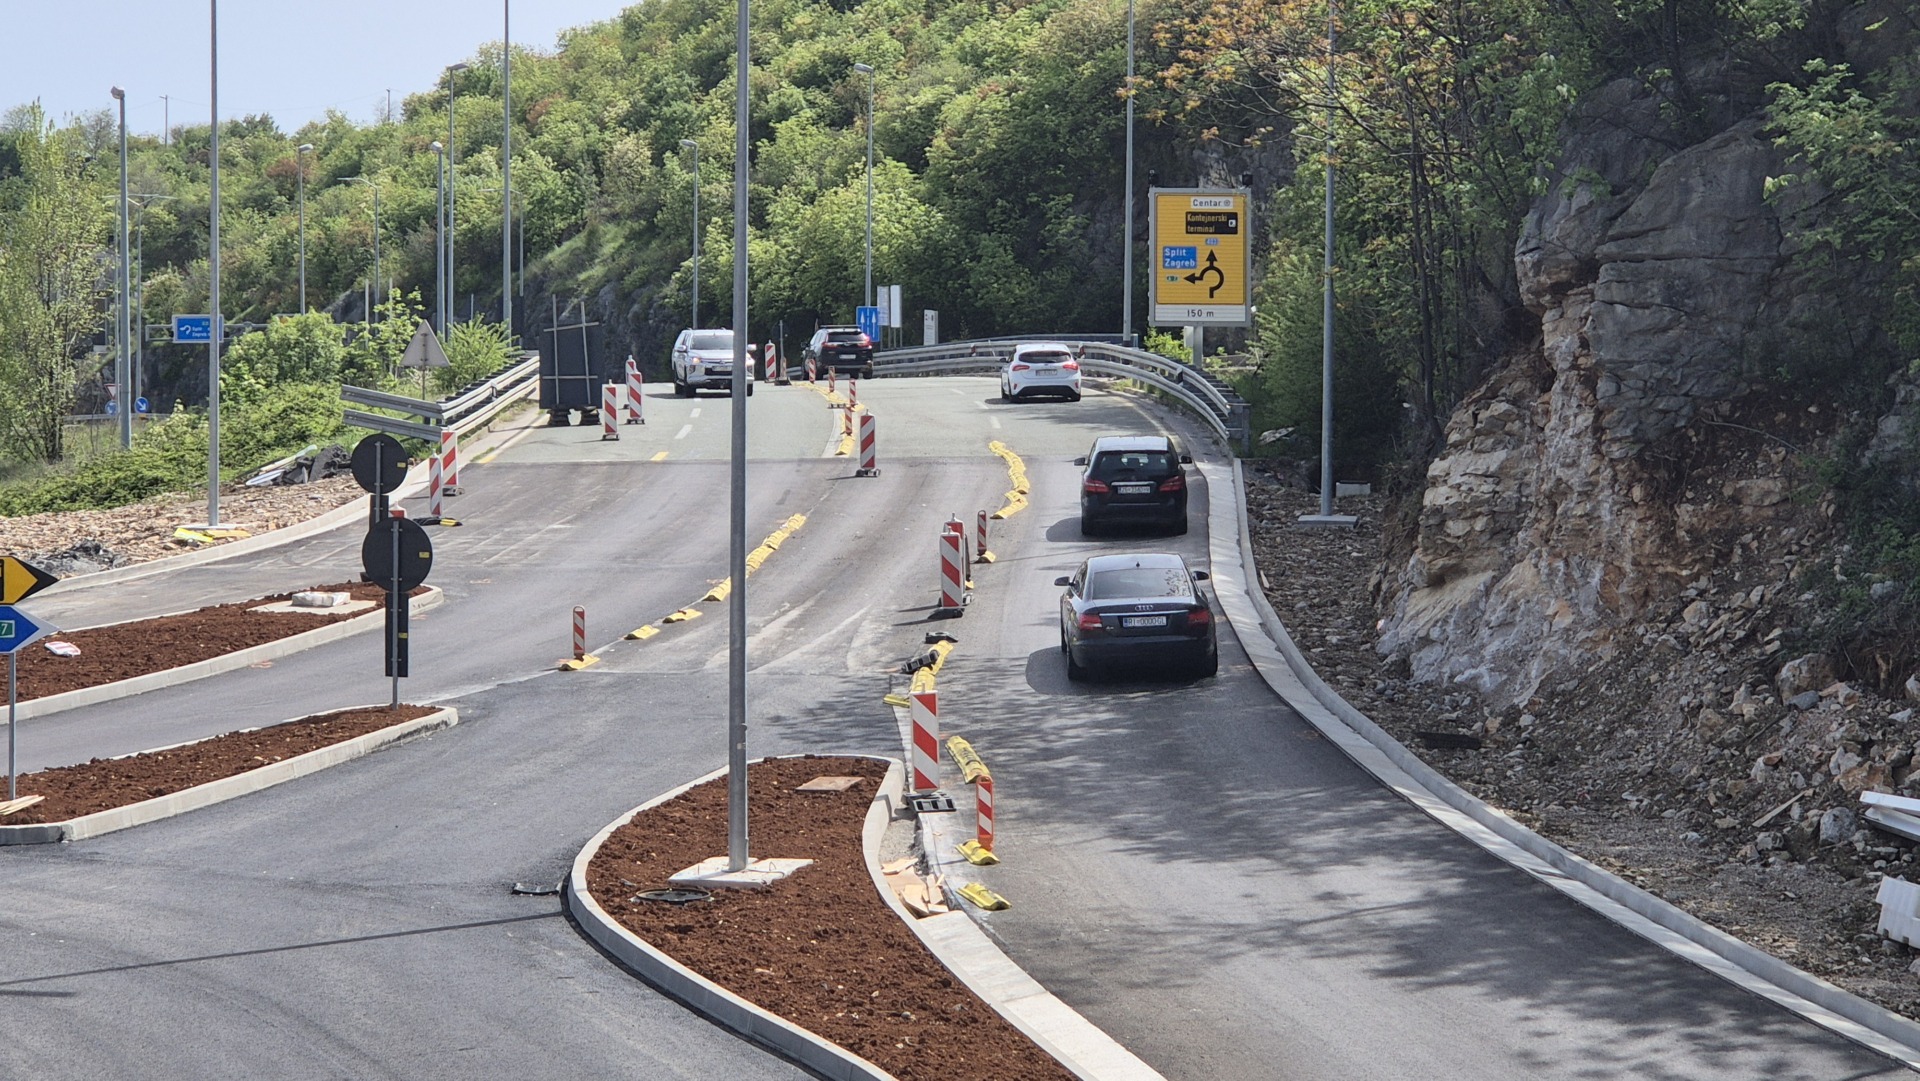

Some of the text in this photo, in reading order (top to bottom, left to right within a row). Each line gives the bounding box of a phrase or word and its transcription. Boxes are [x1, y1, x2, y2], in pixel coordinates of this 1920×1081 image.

[1193, 199, 1221, 207] Centar
[1187, 213, 1227, 223] Kontejnerski
[1187, 225, 1215, 233] terminal
[1164, 247, 1186, 258] Split
[1164, 258, 1195, 269] Zagreb
[1187, 309, 1203, 318] 150
